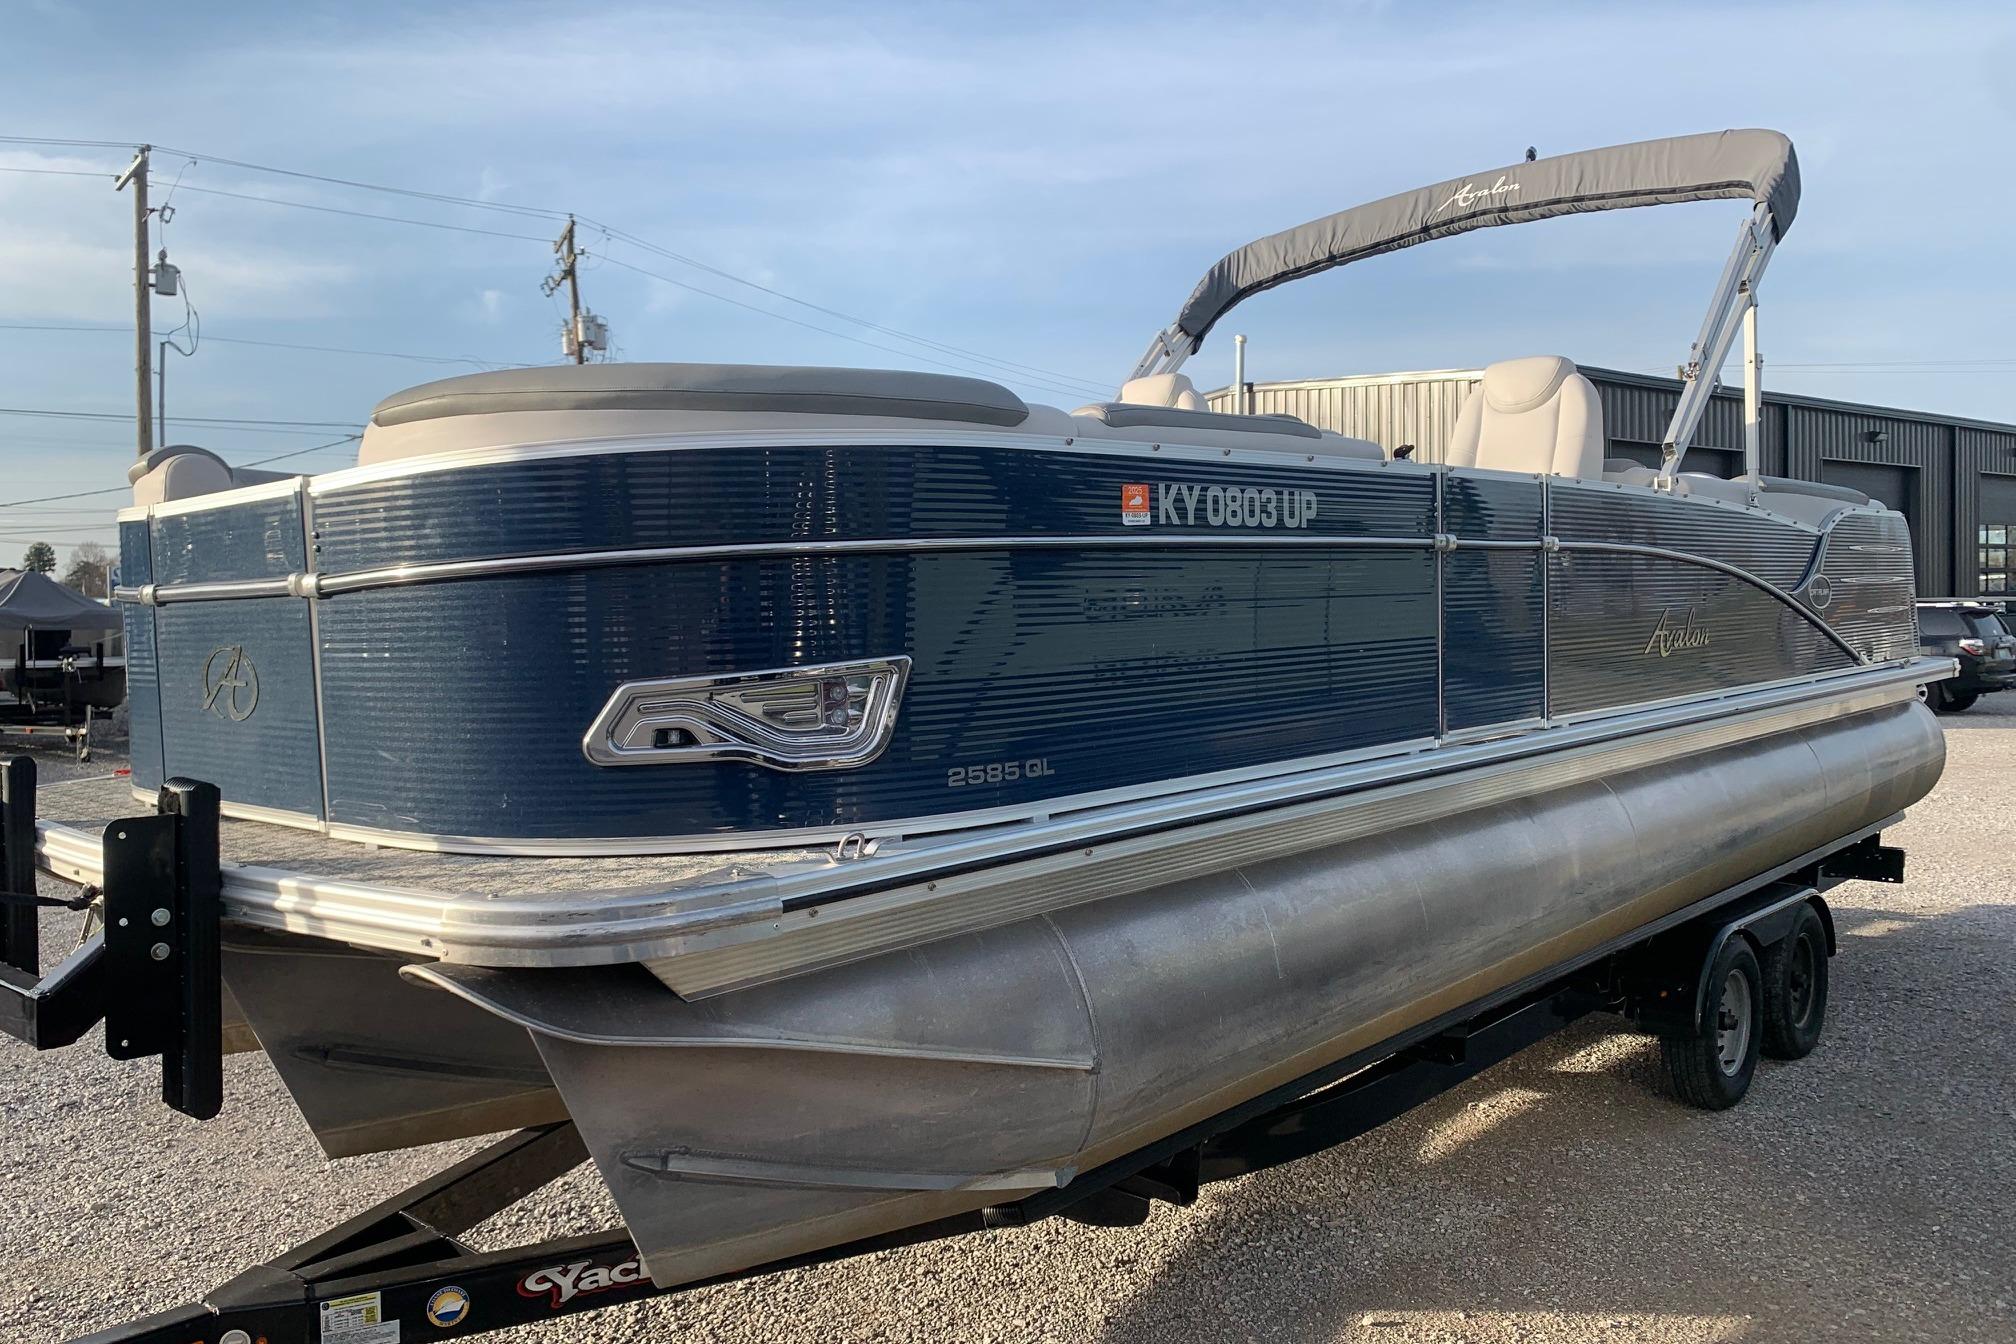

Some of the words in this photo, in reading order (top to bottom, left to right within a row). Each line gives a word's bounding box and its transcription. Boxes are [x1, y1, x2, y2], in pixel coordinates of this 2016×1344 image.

[1437, 175, 1520, 212] Avalon
[1158, 483, 1202, 526] KY
[1206, 486, 1278, 528] 0803
[1283, 488, 1318, 529] UP
[1644, 607, 1710, 657] Avalon
[947, 761, 1020, 787] 2585
[1025, 758, 1056, 778] QL
